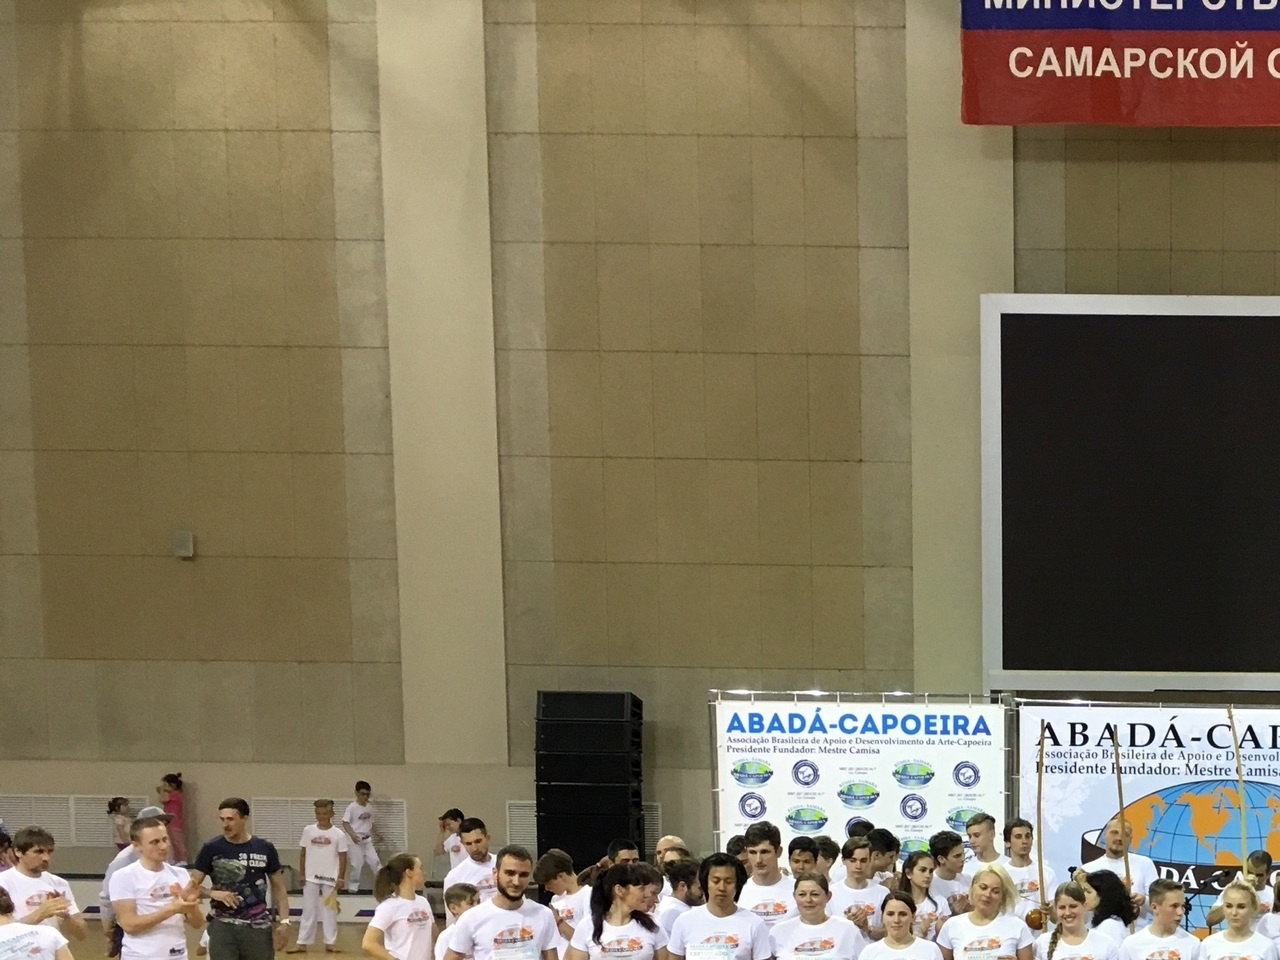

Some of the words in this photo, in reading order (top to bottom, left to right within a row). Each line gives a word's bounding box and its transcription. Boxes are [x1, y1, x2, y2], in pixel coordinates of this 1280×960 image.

[1008, 40, 1254, 79] САМАРСКОЙ
[726, 707, 992, 736] ABADÁ-CAPOEIRA
[726, 736, 769, 745] Associação
[771, 736, 808, 744] Brasileira
[822, 737, 847, 746] Apoio
[938, 739, 992, 747] Arte-Capoeira
[726, 745, 771, 753] Presidente
[773, 746, 816, 754] Fundador:
[818, 746, 847, 754] Mestre
[849, 746, 880, 754] Camisa
[1102, 749, 1156, 760] Brsileira
[1160, 751, 1173, 760] de
[1177, 750, 1213, 763] Apoio
[1216, 753, 1222, 761] e
[1184, 764, 1231, 776] Mestre
